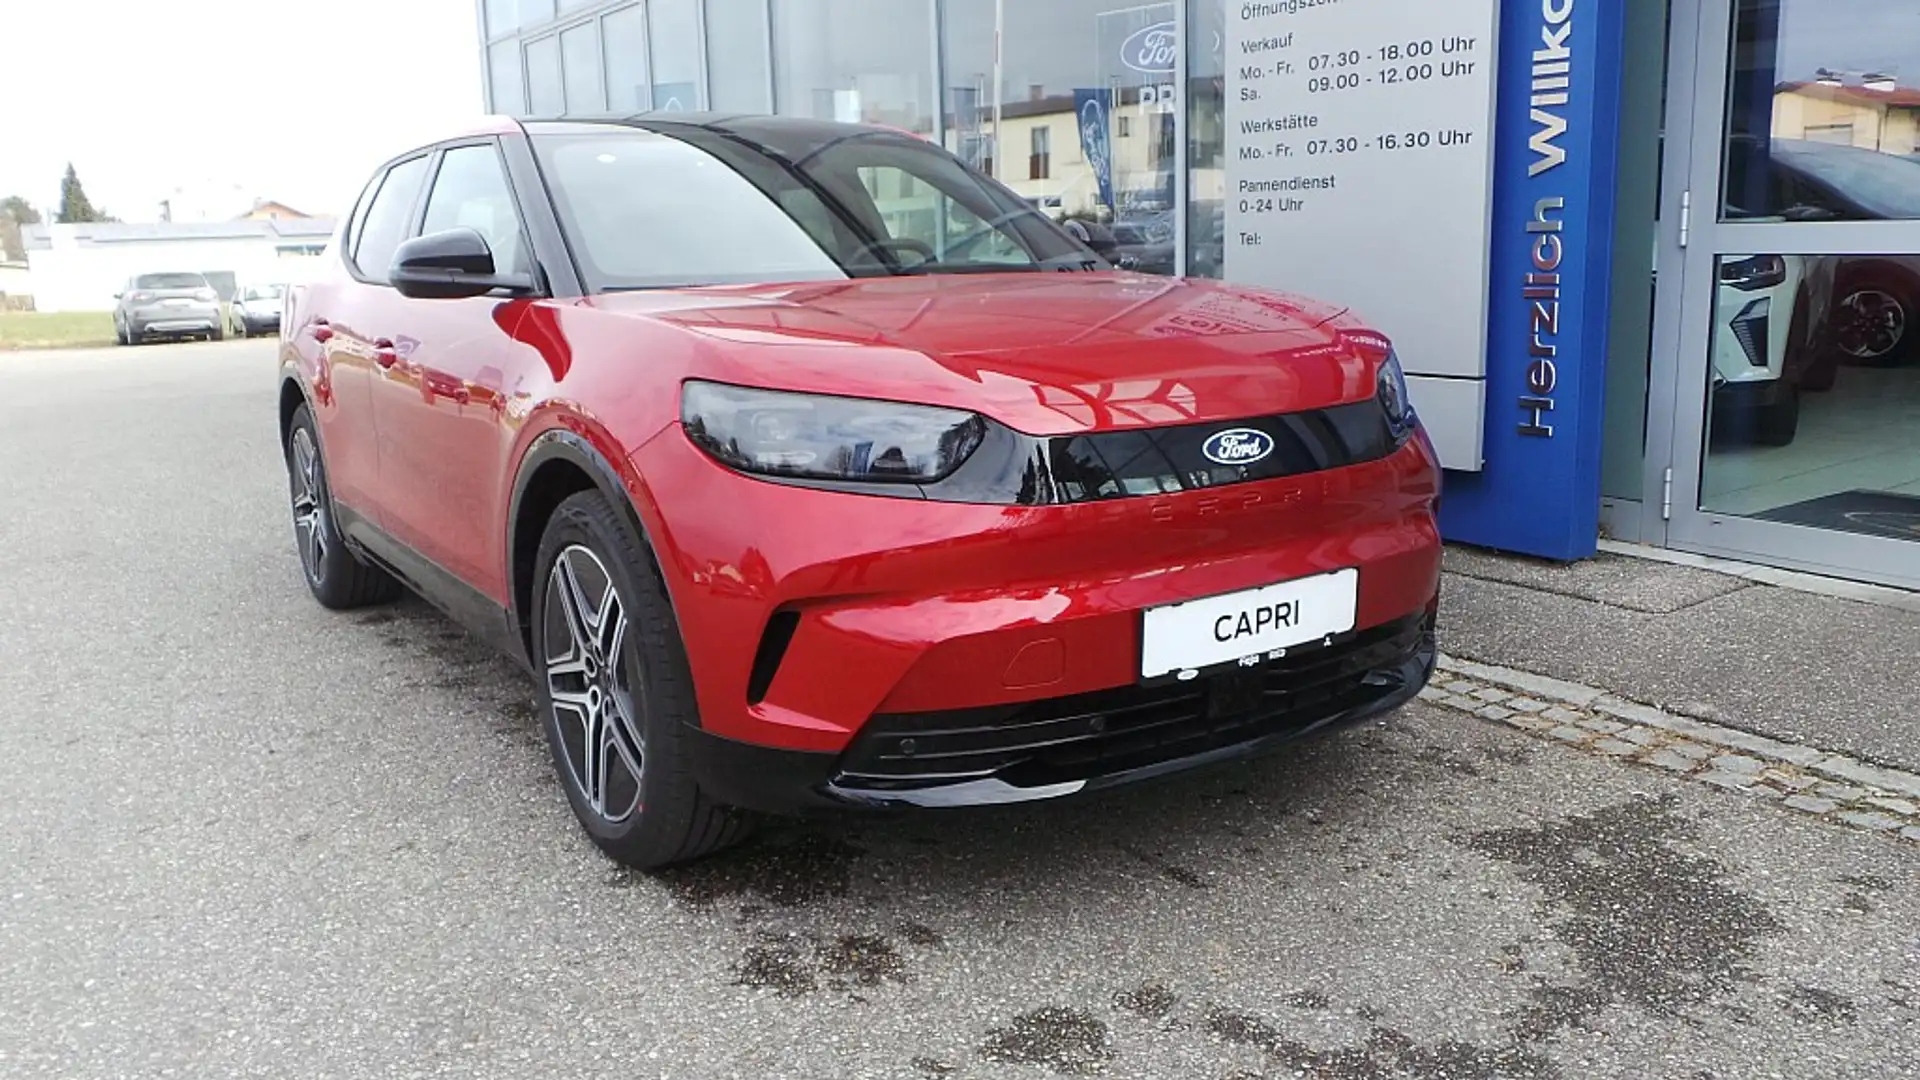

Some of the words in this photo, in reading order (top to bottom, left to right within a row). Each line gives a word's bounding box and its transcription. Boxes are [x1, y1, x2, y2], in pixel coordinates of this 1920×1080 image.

[1241, 32, 1293, 54] Verkauf
[1308, 50, 1360, 71] 07.30
[1379, 40, 1433, 61] 18.00
[1441, 36, 1476, 53] Uhr
[1240, 87, 1261, 101] Sa.
[1308, 73, 1359, 93] 09.00
[1379, 63, 1432, 84] 12.00
[1441, 60, 1475, 77] Uhr
[1240, 114, 1318, 134] Werkstätte
[1306, 136, 1358, 155] 07.30
[1376, 131, 1430, 150] 16.30
[1438, 129, 1473, 146] Uhr
[1239, 174, 1336, 193] Pannendienst
[1278, 198, 1304, 212] Uhr
[1239, 232, 1262, 246] Tel:
[1516, 196, 1565, 438] Herzlich
[1218, 433, 1262, 458] Ford
[1213, 599, 1300, 643] CAPRI
